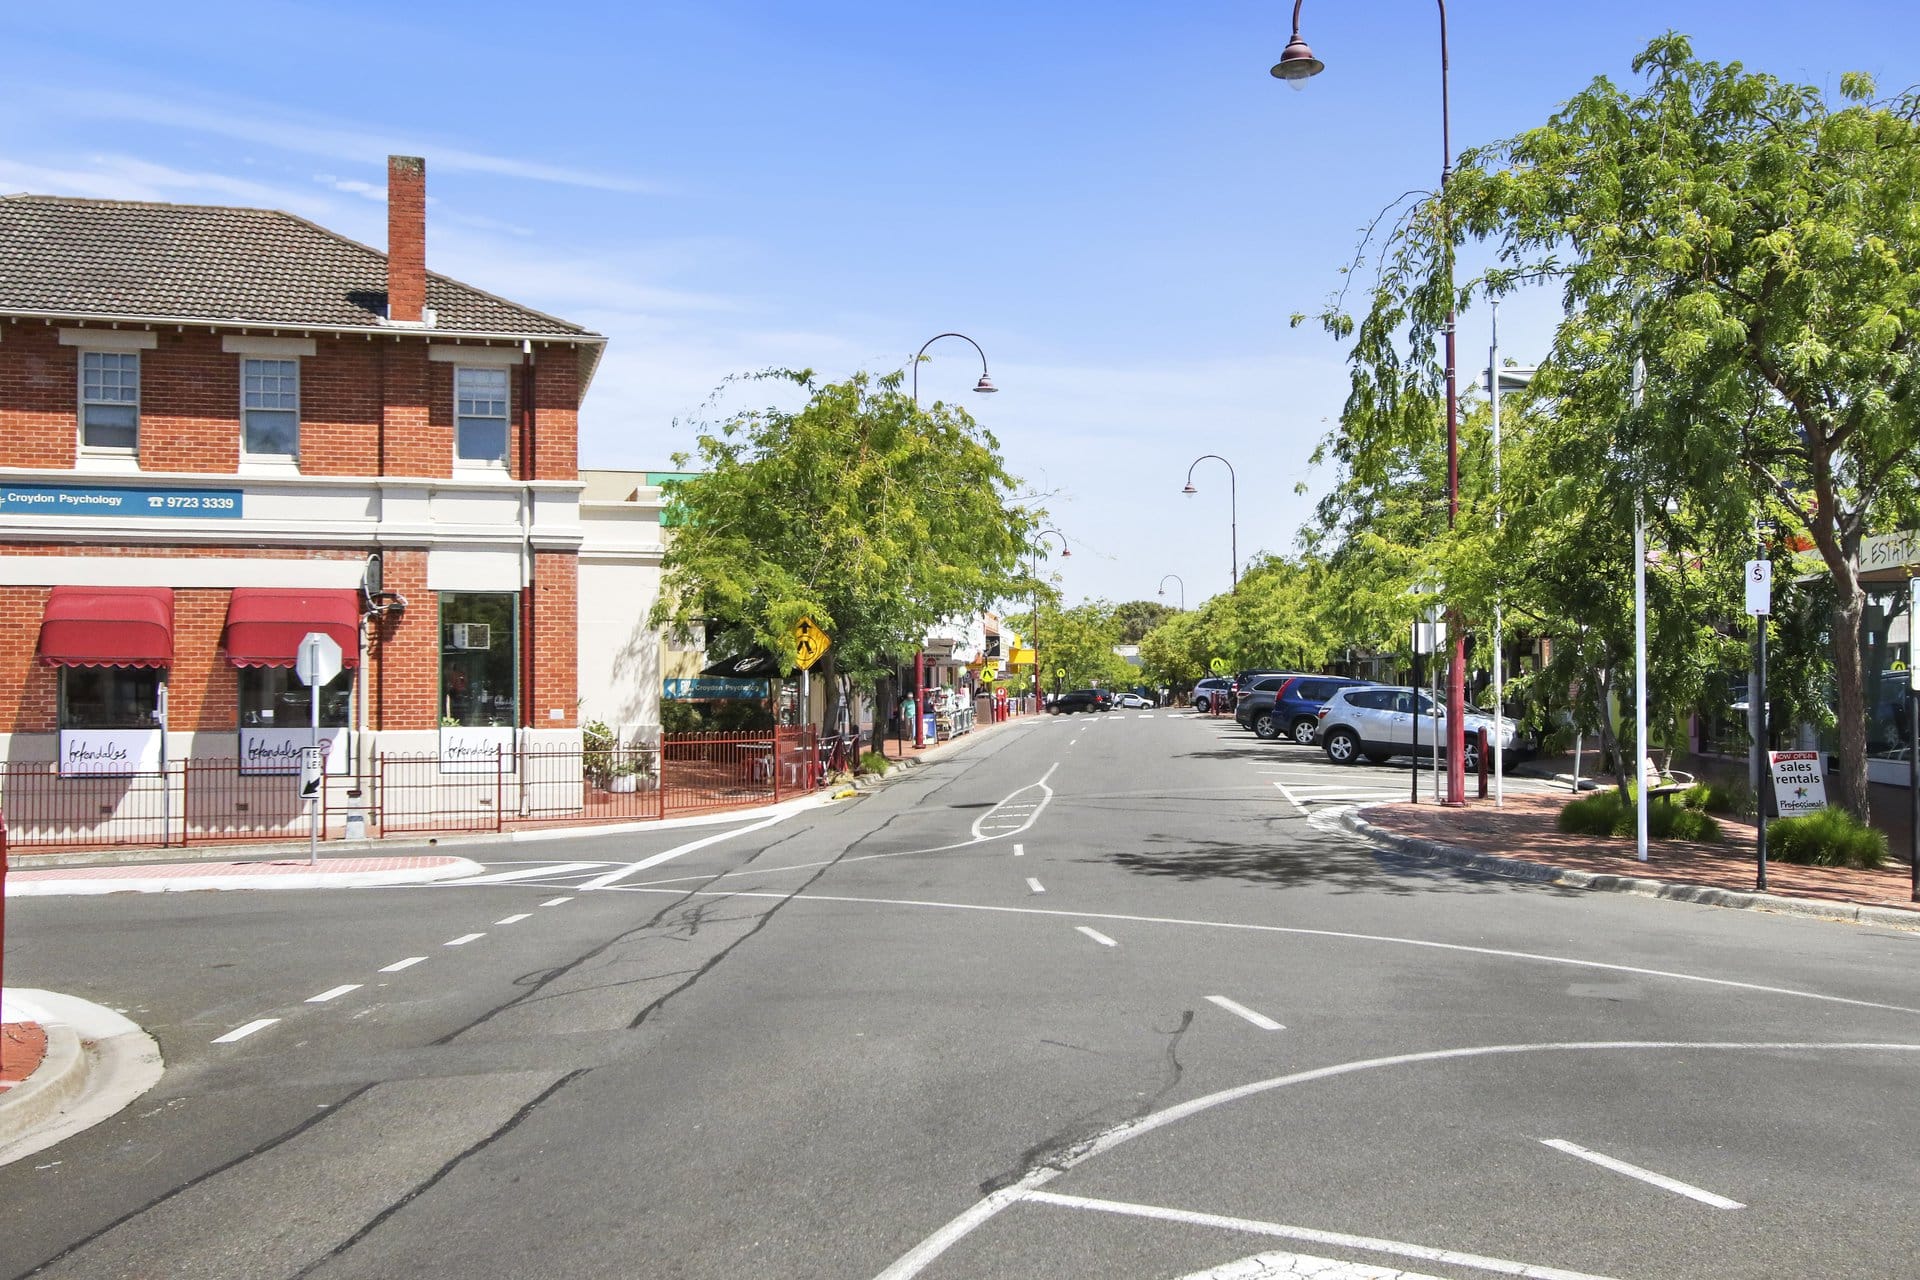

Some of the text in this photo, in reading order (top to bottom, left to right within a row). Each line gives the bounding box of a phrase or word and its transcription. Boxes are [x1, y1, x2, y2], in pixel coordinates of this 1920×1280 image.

[8, 492, 122, 506] Croydon Psychology
[167, 496, 234, 509] 9723 3339
[1871, 538, 1916, 564] ESTATE
[696, 684, 723, 692] Croydon
[1780, 761, 1812, 772] sales
[1775, 773, 1821, 784] rentals
[1779, 800, 1825, 811] Professionals
